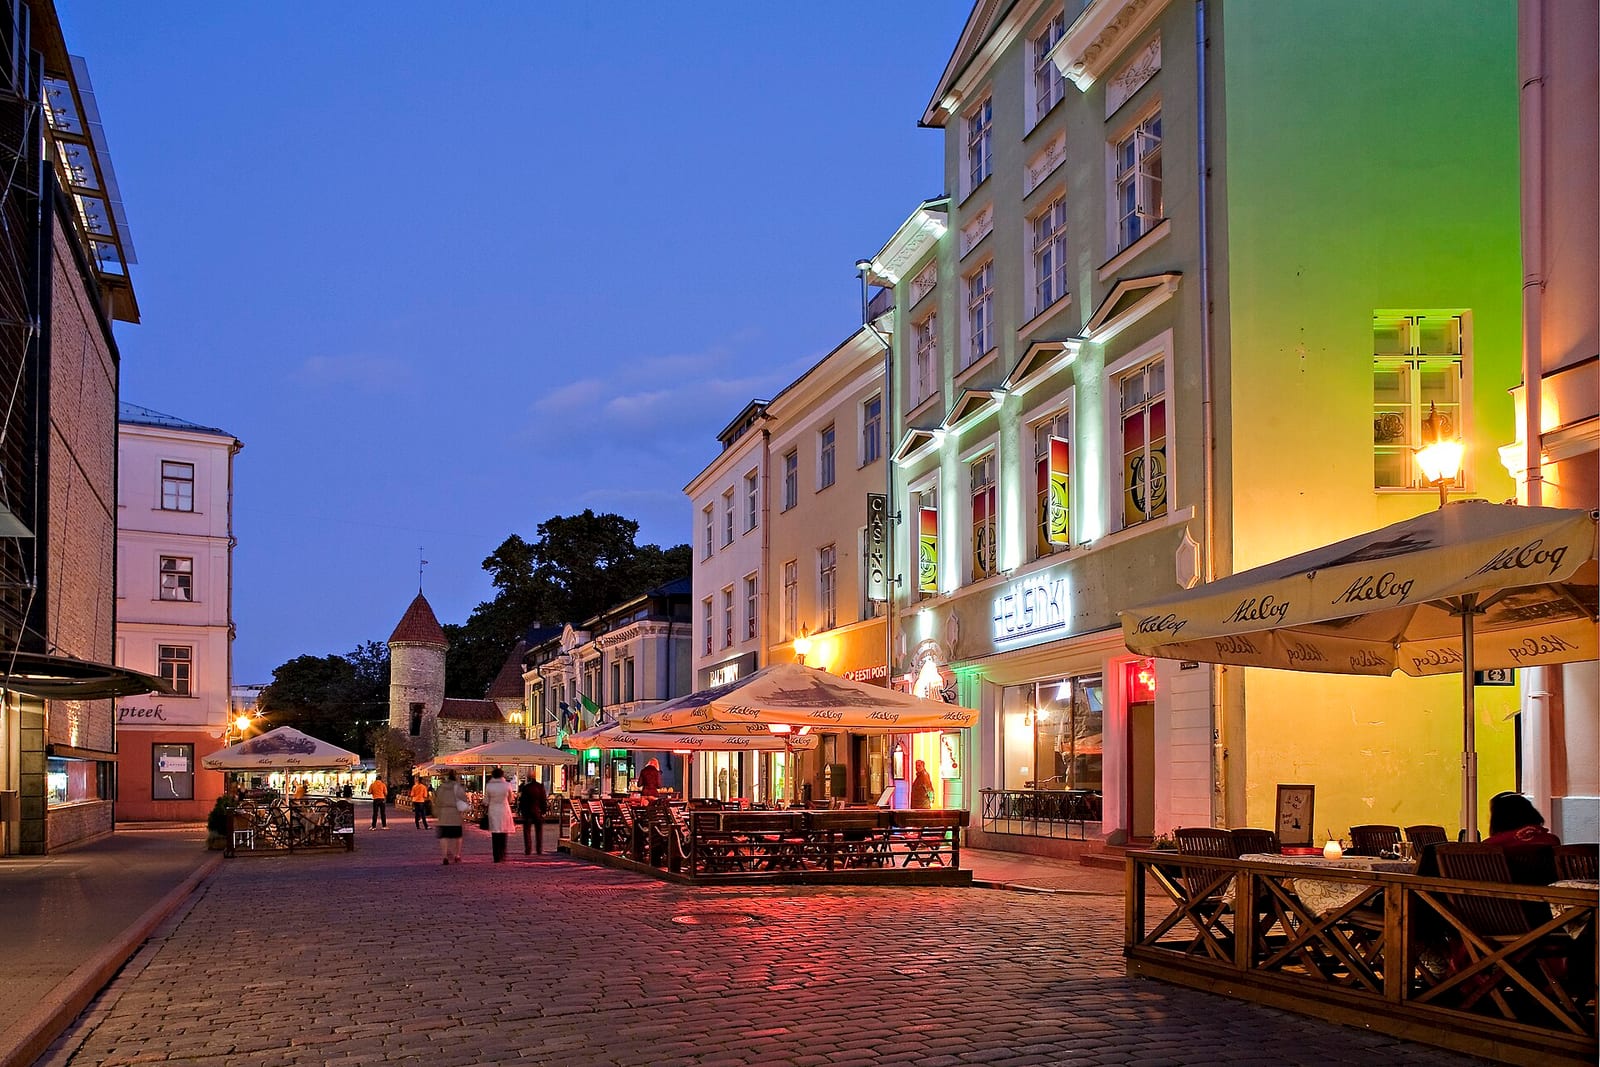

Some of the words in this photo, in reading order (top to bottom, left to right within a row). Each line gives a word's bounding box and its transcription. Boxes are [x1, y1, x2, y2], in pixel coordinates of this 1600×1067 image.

[871, 498, 884, 584] CASINO
[992, 577, 1066, 639] HELSINKI
[854, 667, 871, 682] EESTI
[872, 665, 888, 679] POST
[119, 703, 167, 721] pteek
